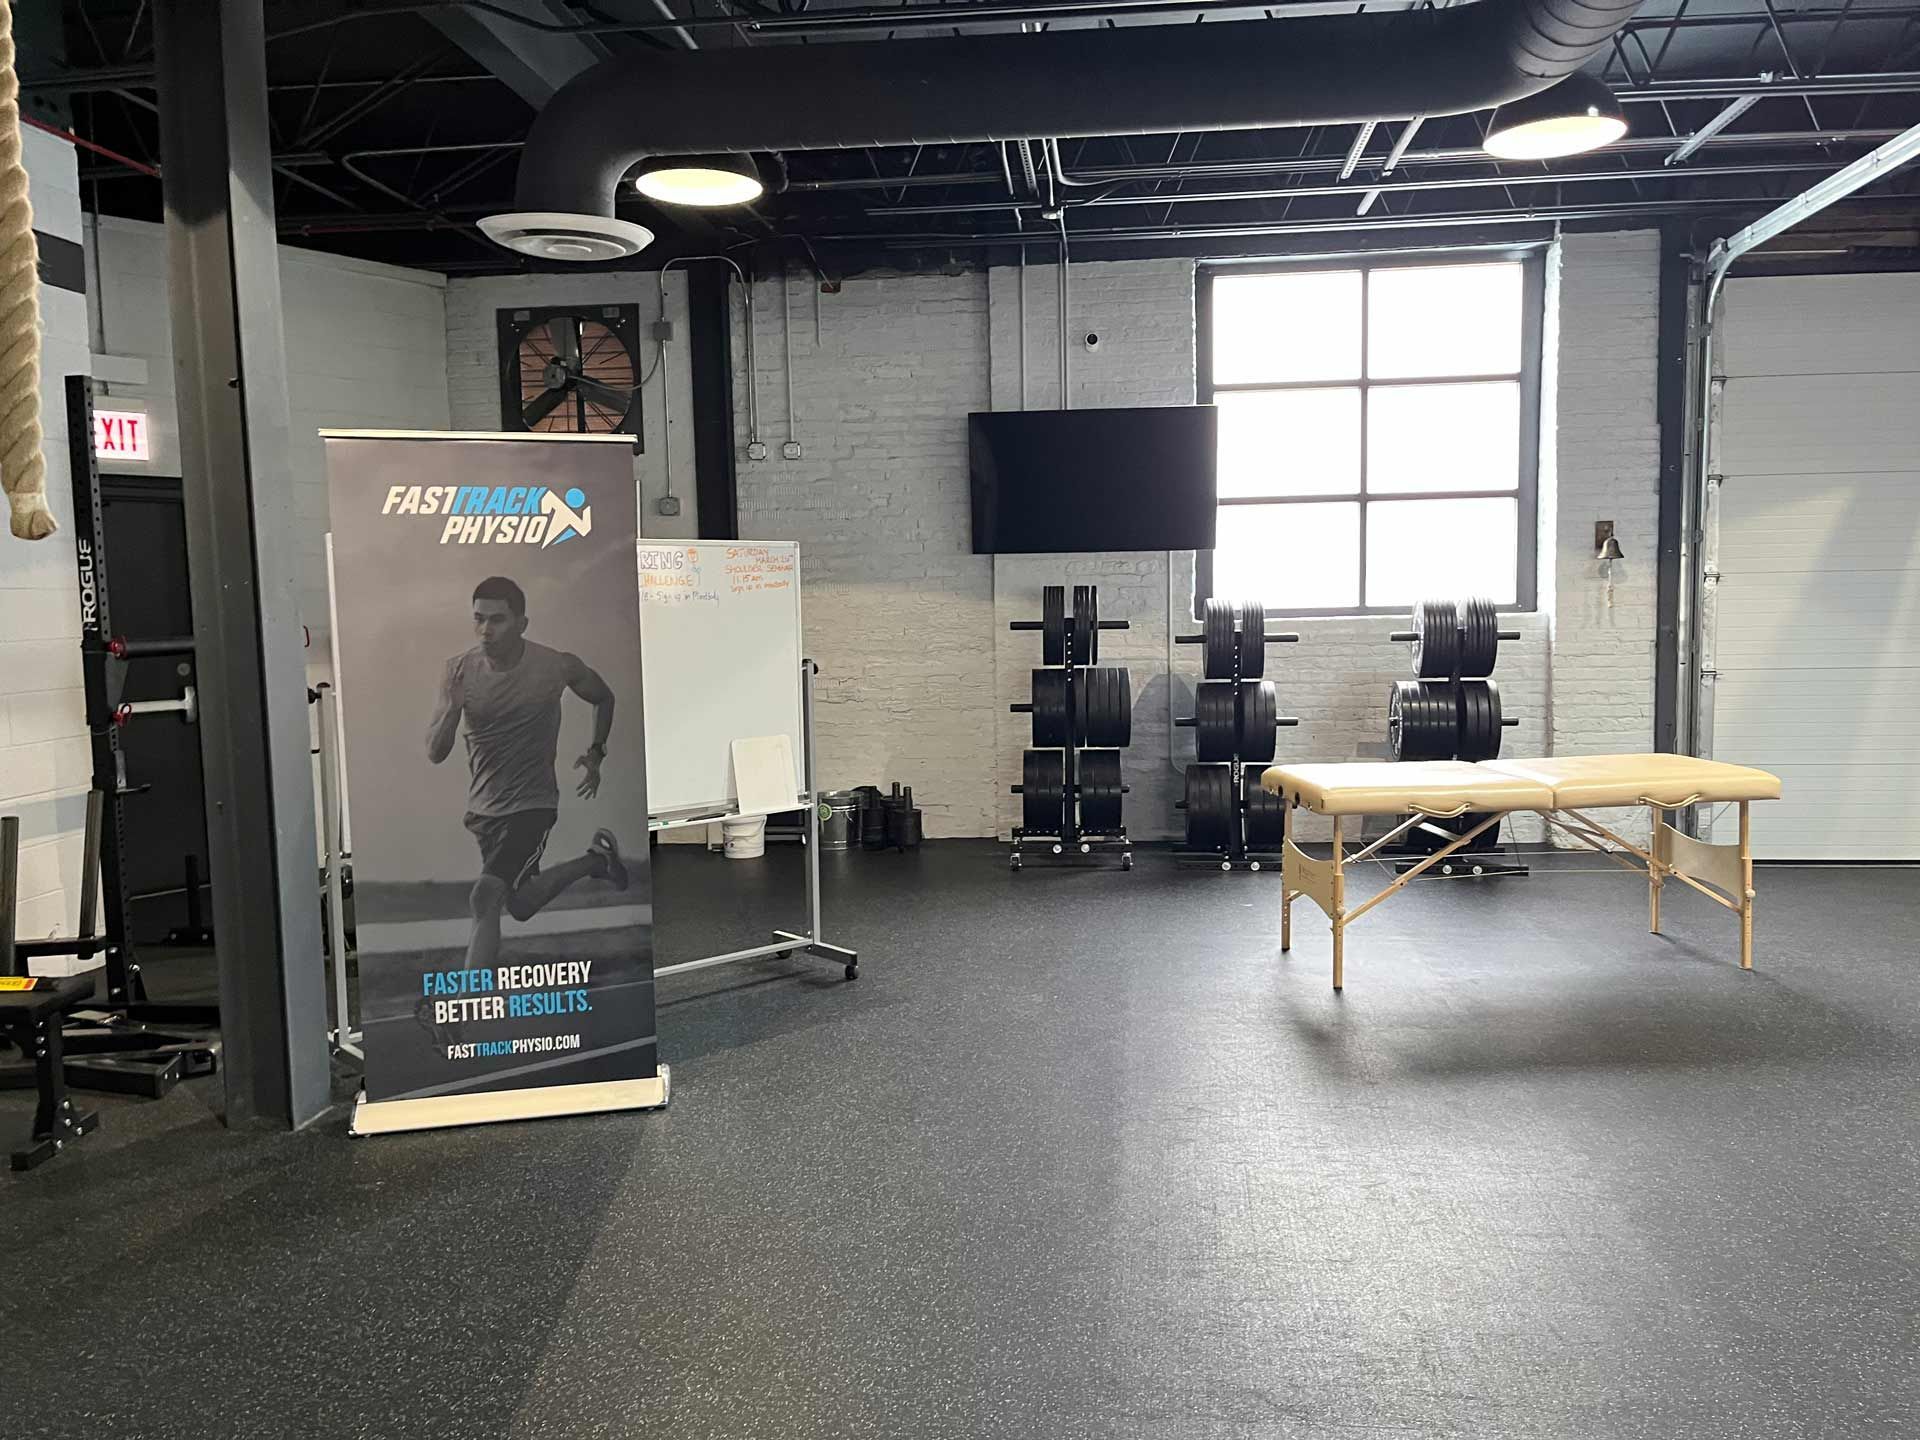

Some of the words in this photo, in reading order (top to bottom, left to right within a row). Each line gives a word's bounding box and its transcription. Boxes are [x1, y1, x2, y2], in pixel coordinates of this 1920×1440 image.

[94, 417, 138, 451] XIT
[439, 516, 548, 544] PHYSIO
[639, 551, 684, 570] RING
[79, 538, 98, 630] ROGUE
[423, 968, 494, 997] FASTER
[497, 960, 592, 991] RECOVERY
[435, 996, 505, 1025] BETTER
[508, 989, 592, 1018] RESULTS.
[447, 1034, 580, 1060] FASTTRACKPHYSIO.COM
